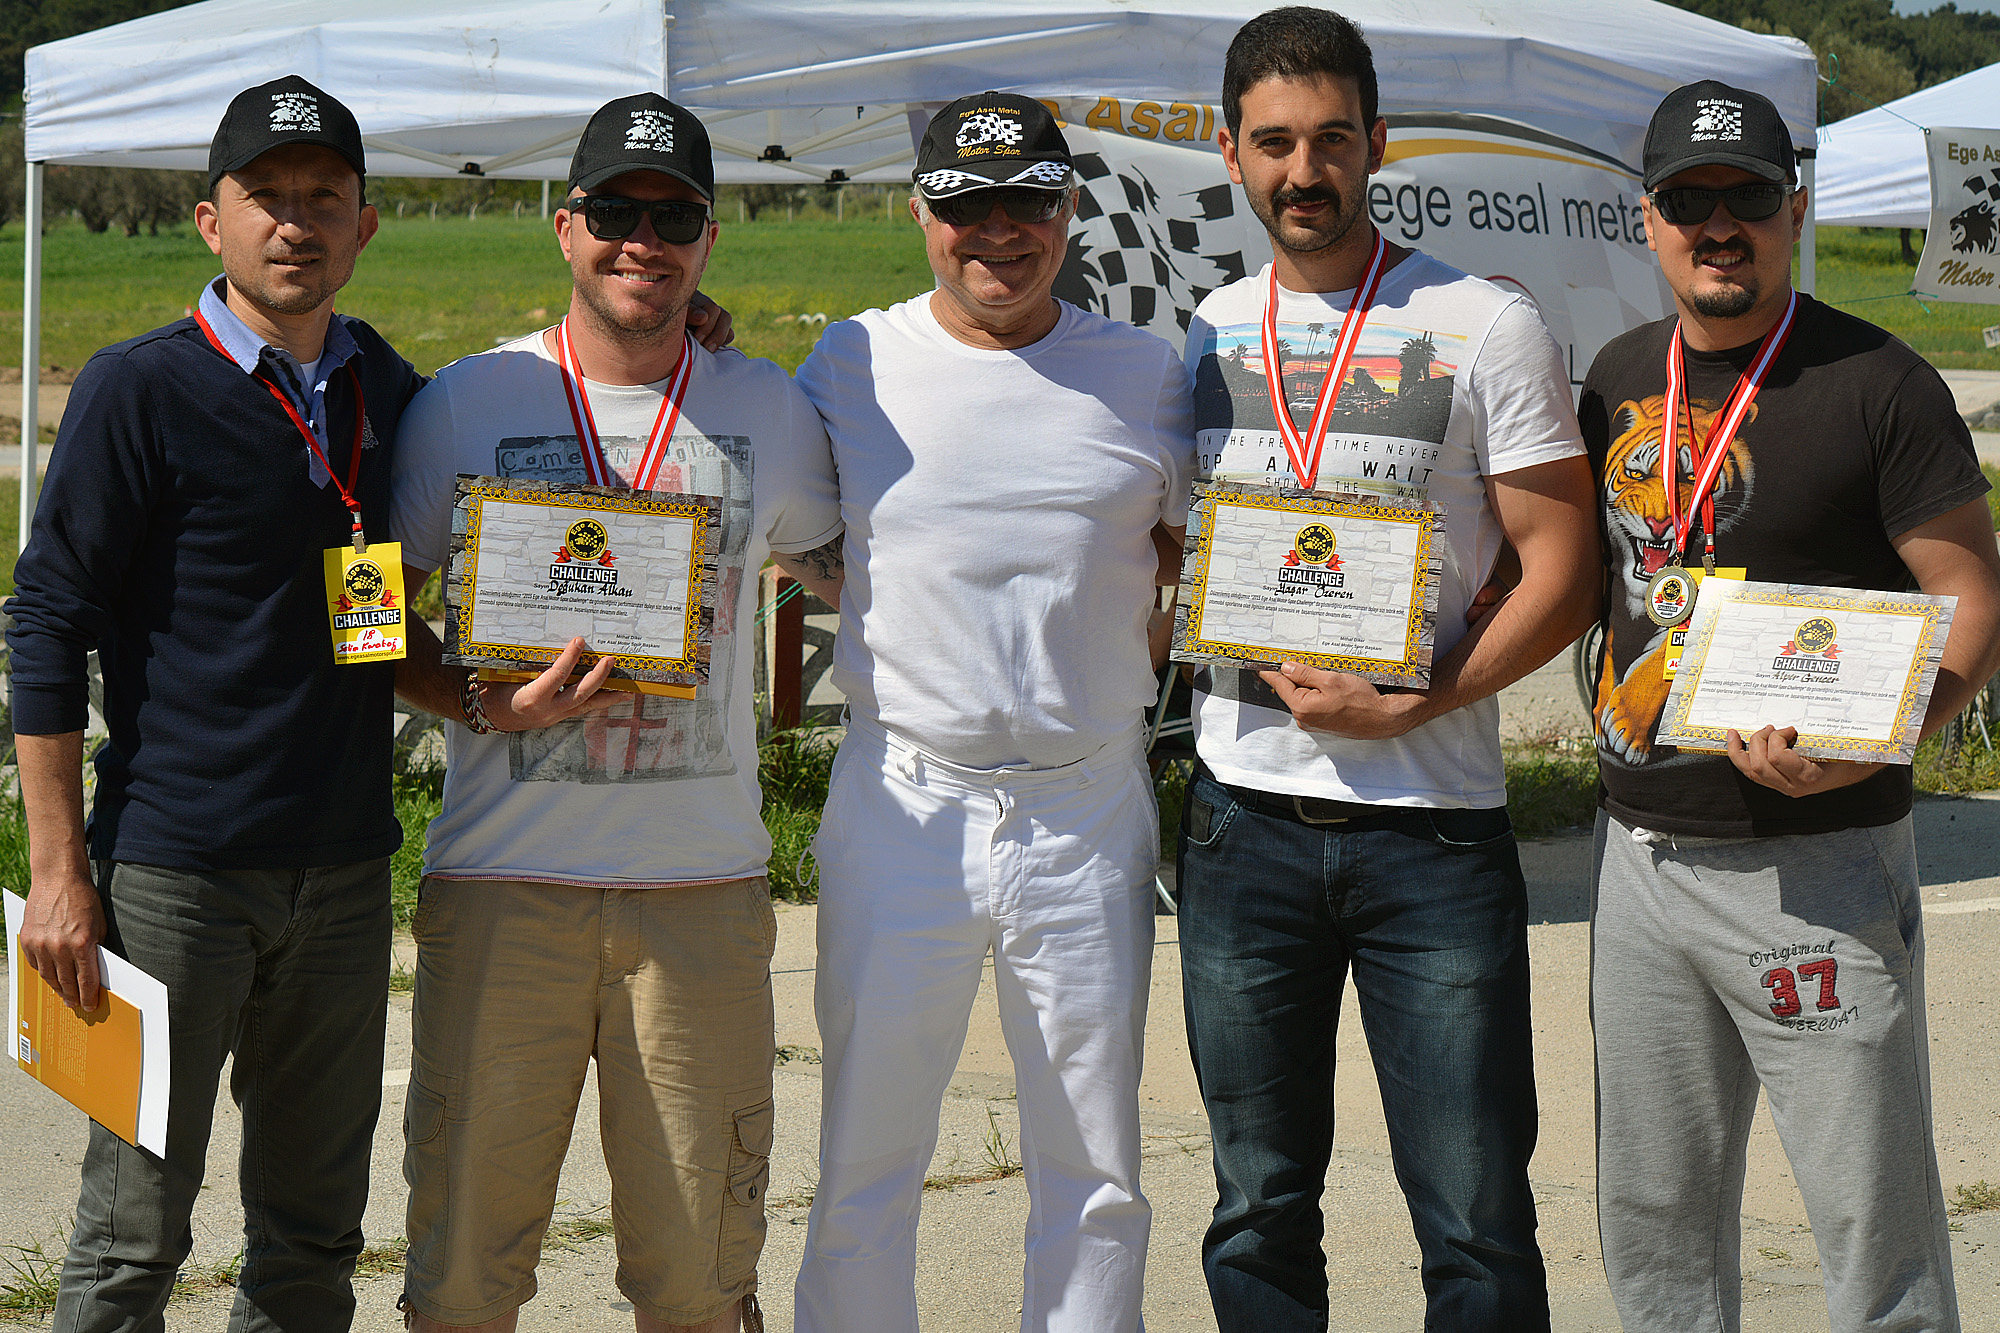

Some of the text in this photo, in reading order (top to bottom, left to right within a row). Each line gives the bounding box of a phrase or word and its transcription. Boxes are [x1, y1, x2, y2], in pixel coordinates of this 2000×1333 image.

[1725, 100, 1742, 109] Metal
[659, 112, 674, 122] Metal
[1086, 96, 1214, 142] Asal
[270, 123, 321, 133] Motor Spor
[1690, 132, 1741, 142] Motor Spor
[624, 141, 673, 153] Motor Spor
[957, 145, 1022, 159] Motor Spor
[1948, 142, 2000, 165] Ege As
[1368, 182, 1648, 245] ege asal meta
[1938, 259, 1994, 287] Motor
[1203, 436, 1212, 446] IN
[1222, 435, 1245, 446] THE
[1335, 440, 1370, 452] TIME
[1386, 444, 1438, 460] NEVER
[1363, 460, 1433, 483] WAIT
[1336, 481, 1358, 492] THE
[551, 566, 616, 582] CHALLENGE
[1280, 569, 1343, 586] CHALLENGE
[335, 610, 400, 628] CHALLENGE
[363, 630, 375, 640] 18
[1672, 632, 1687, 646] CH
[1774, 658, 1839, 673] CHALLENGE
[1748, 940, 1836, 967] Original
[1760, 958, 1841, 1019] 37
